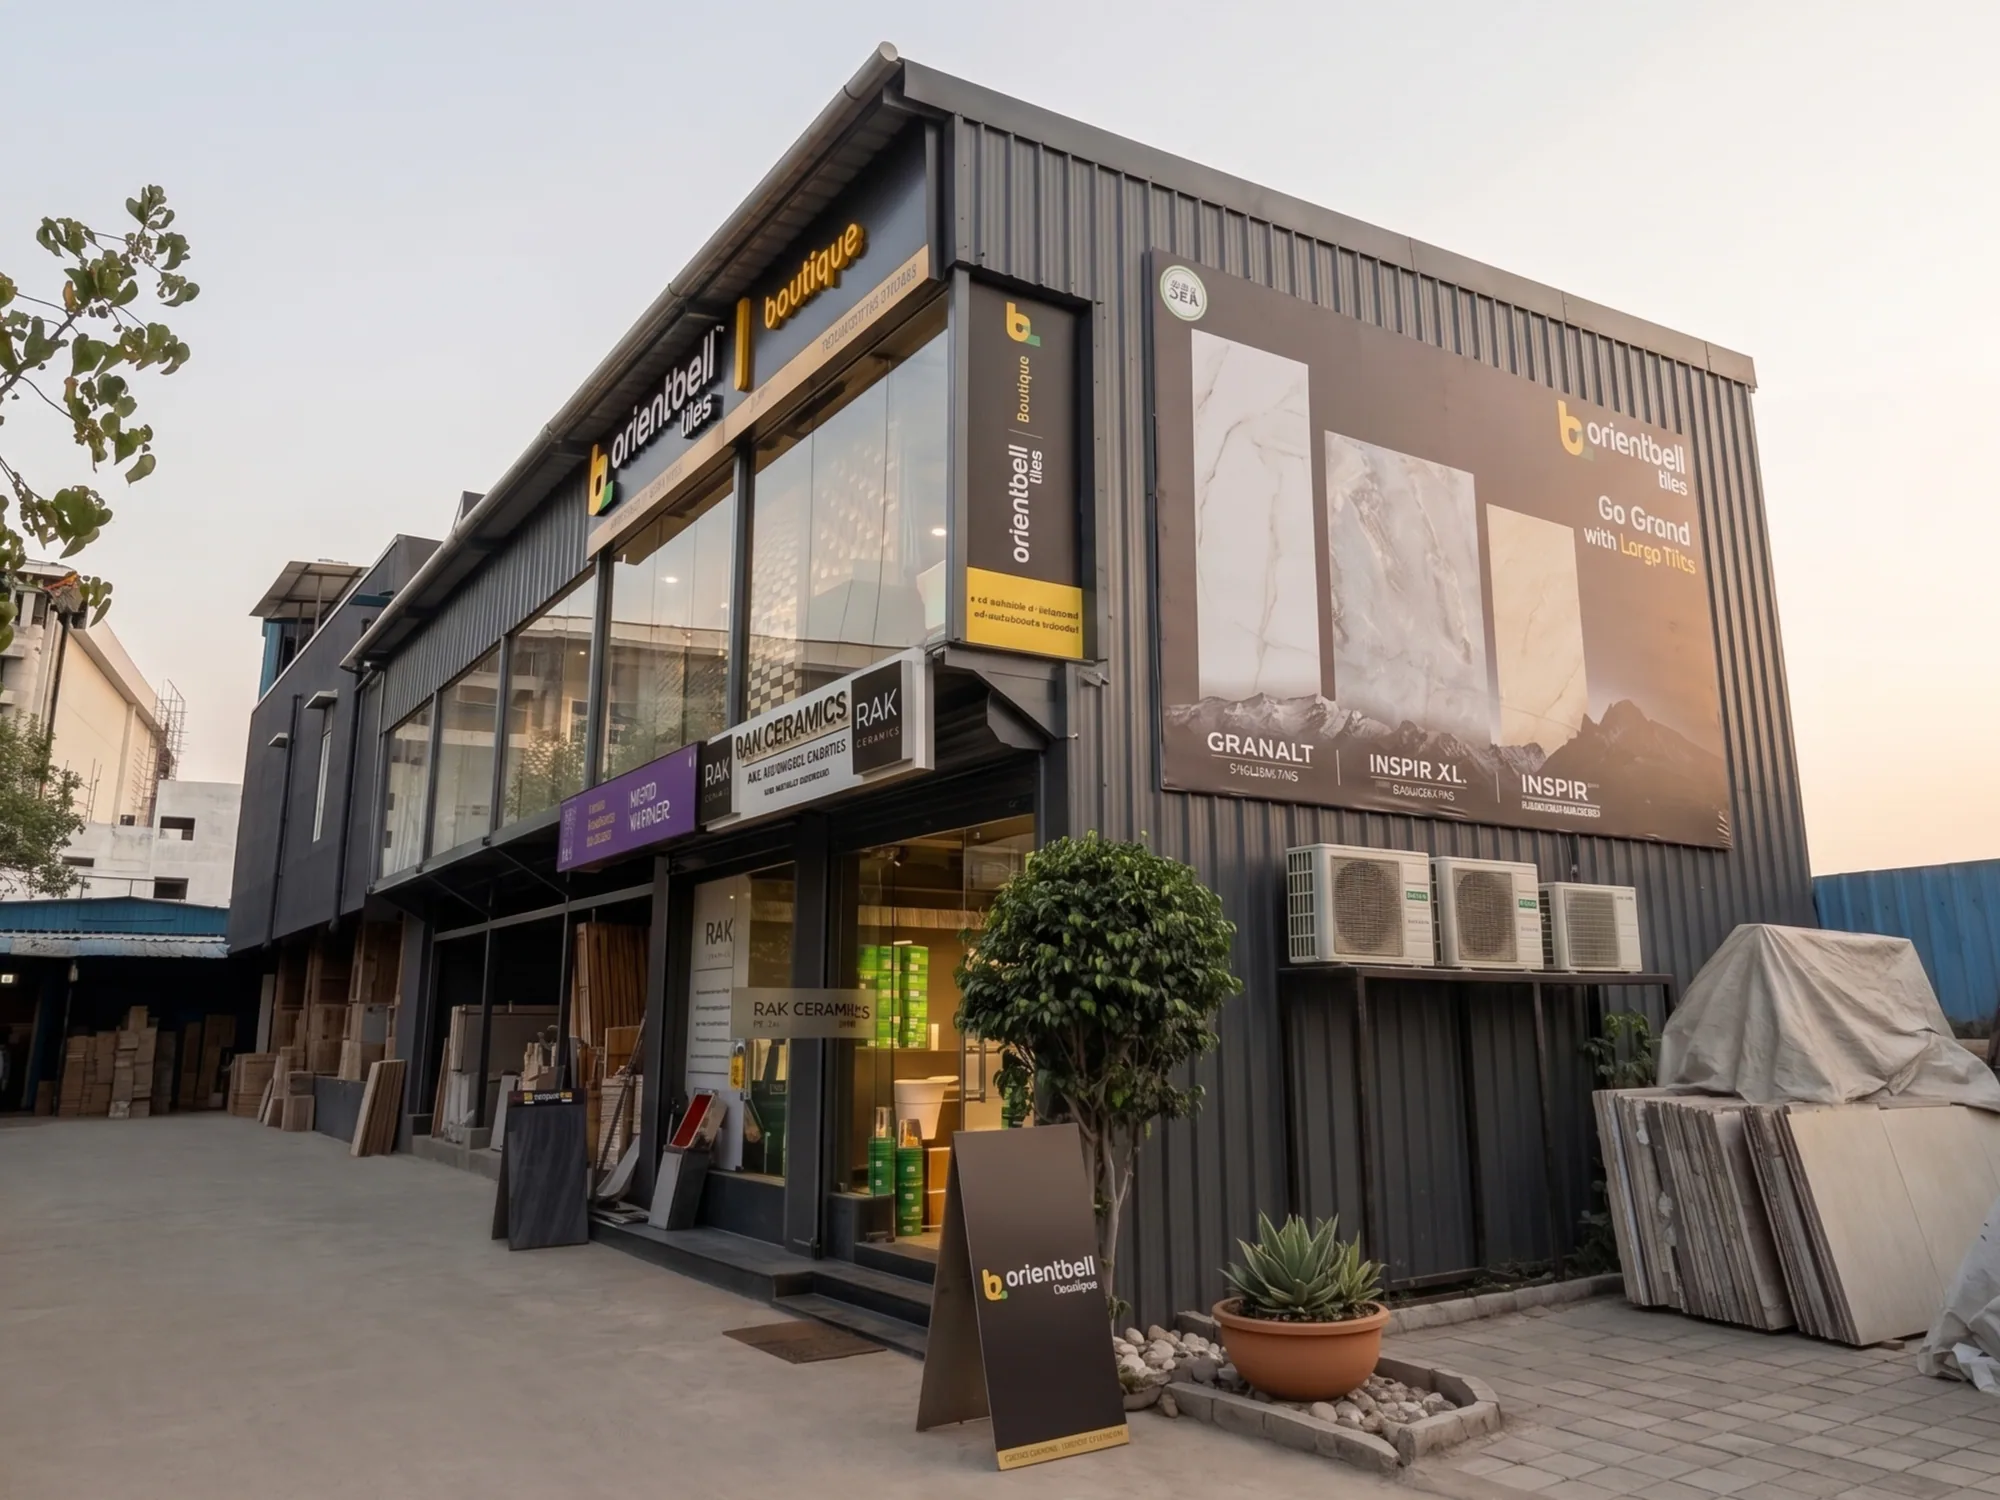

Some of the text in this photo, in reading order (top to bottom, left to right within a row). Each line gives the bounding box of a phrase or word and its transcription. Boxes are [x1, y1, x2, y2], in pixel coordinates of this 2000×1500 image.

[764, 223, 862, 329] boutique
[611, 329, 715, 469] orientbell
[681, 393, 712, 438] tiles
[1008, 355, 1032, 563] orientbell Boutique
[1586, 421, 1686, 475] orientbell
[1658, 469, 1688, 496] tiles
[1598, 495, 1691, 547] Go Grand
[1583, 526, 1617, 551] with
[764, 690, 847, 748] CERAMICS
[856, 687, 898, 730] RAK
[1207, 731, 1315, 764] GRANALT
[704, 756, 730, 788] RAK
[1369, 753, 1433, 780] INSPIR
[1521, 773, 1589, 801] INSPIR
[705, 918, 734, 946] RAK
[753, 1001, 789, 1016] RAK
[1005, 1254, 1096, 1288] orientbell
